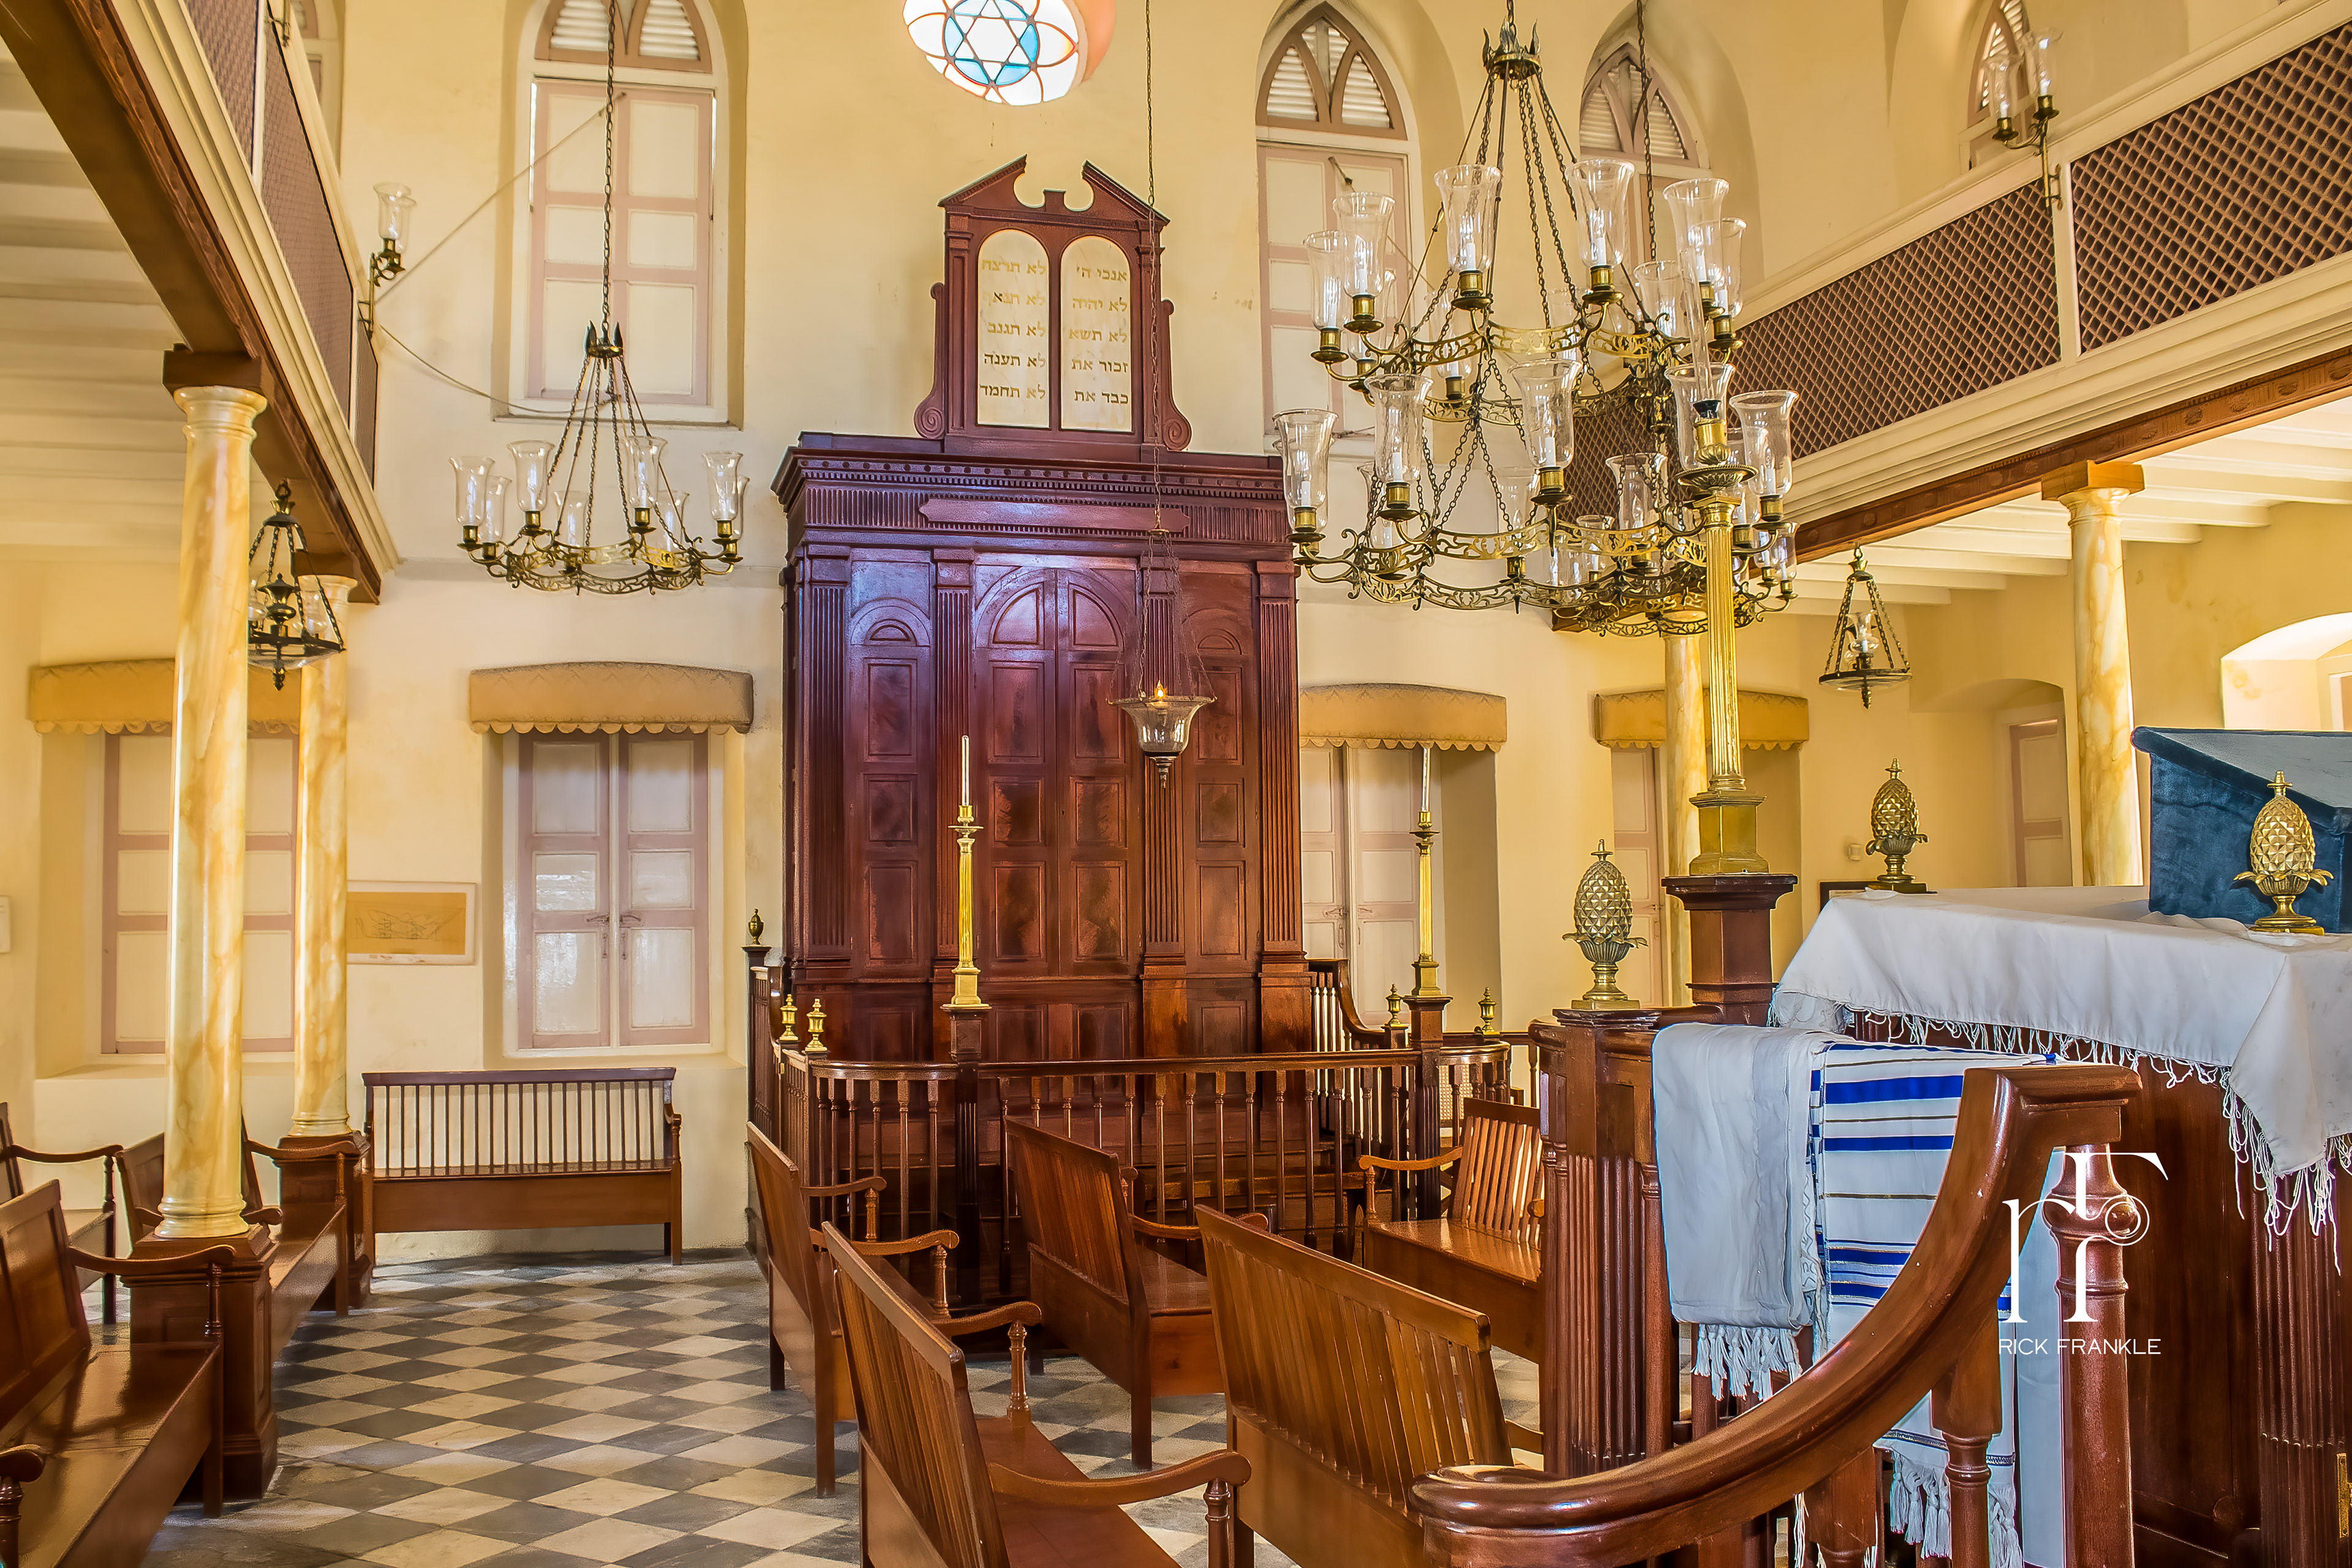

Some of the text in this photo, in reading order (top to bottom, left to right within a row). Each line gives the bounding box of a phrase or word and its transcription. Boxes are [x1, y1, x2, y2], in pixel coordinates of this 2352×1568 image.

[982, 260, 1046, 275] לא תרצח
[1096, 268, 1127, 281] אנכי
[1026, 290, 1045, 306] לא
[1109, 296, 1127, 312] לא
[987, 320, 1046, 337] לא תגנב
[1069, 326, 1127, 343] לא תשא
[984, 352, 1046, 368] לא תענה
[1071, 358, 1128, 373] זכור את
[979, 383, 1046, 399] לא תחמד
[1074, 390, 1128, 405] כבד את
